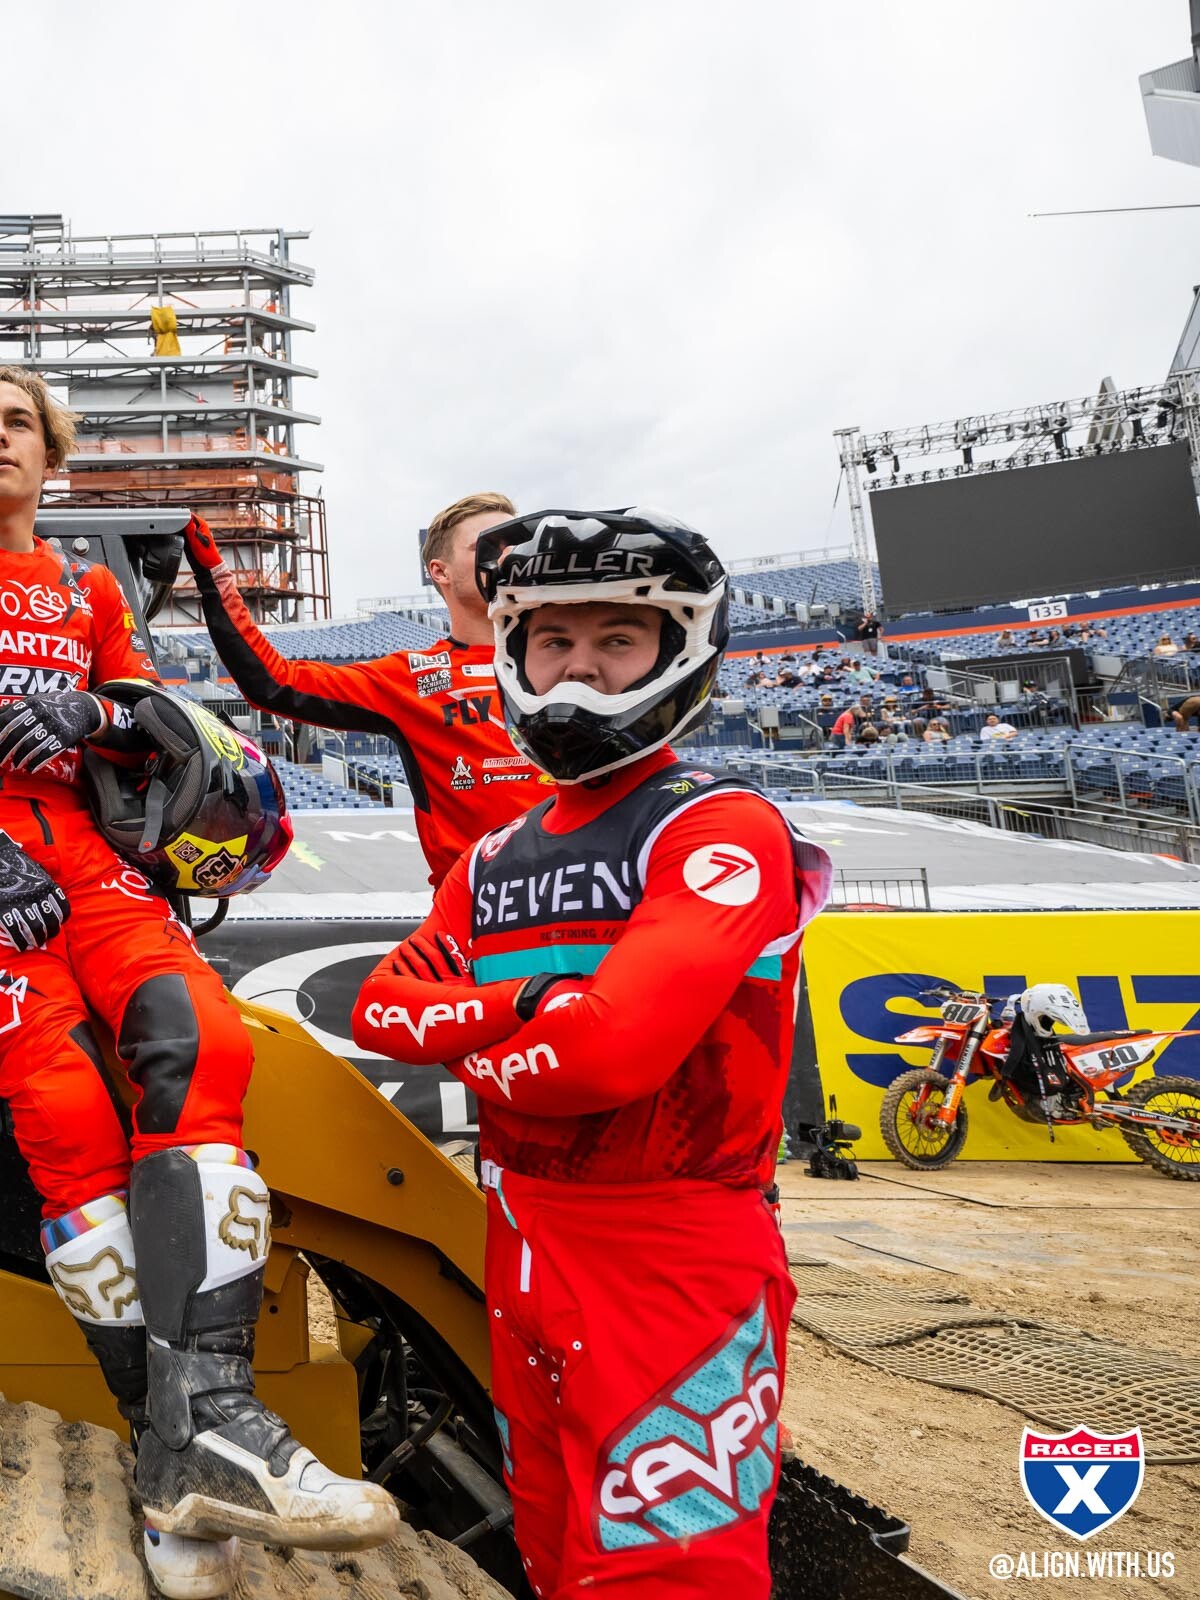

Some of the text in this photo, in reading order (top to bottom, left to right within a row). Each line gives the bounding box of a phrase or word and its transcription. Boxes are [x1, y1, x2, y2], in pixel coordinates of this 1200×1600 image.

[510, 551, 655, 583] MILLER
[1033, 604, 1063, 618] 135
[417, 671, 440, 685] S&W
[427, 683, 452, 693] SERVICE
[441, 696, 492, 727] FLY
[450, 778, 475, 786] ANCHOR
[198, 853, 237, 886] 153
[476, 861, 632, 926] SEVEN
[943, 1004, 980, 1023] 80
[1098, 1046, 1140, 1069] 80
